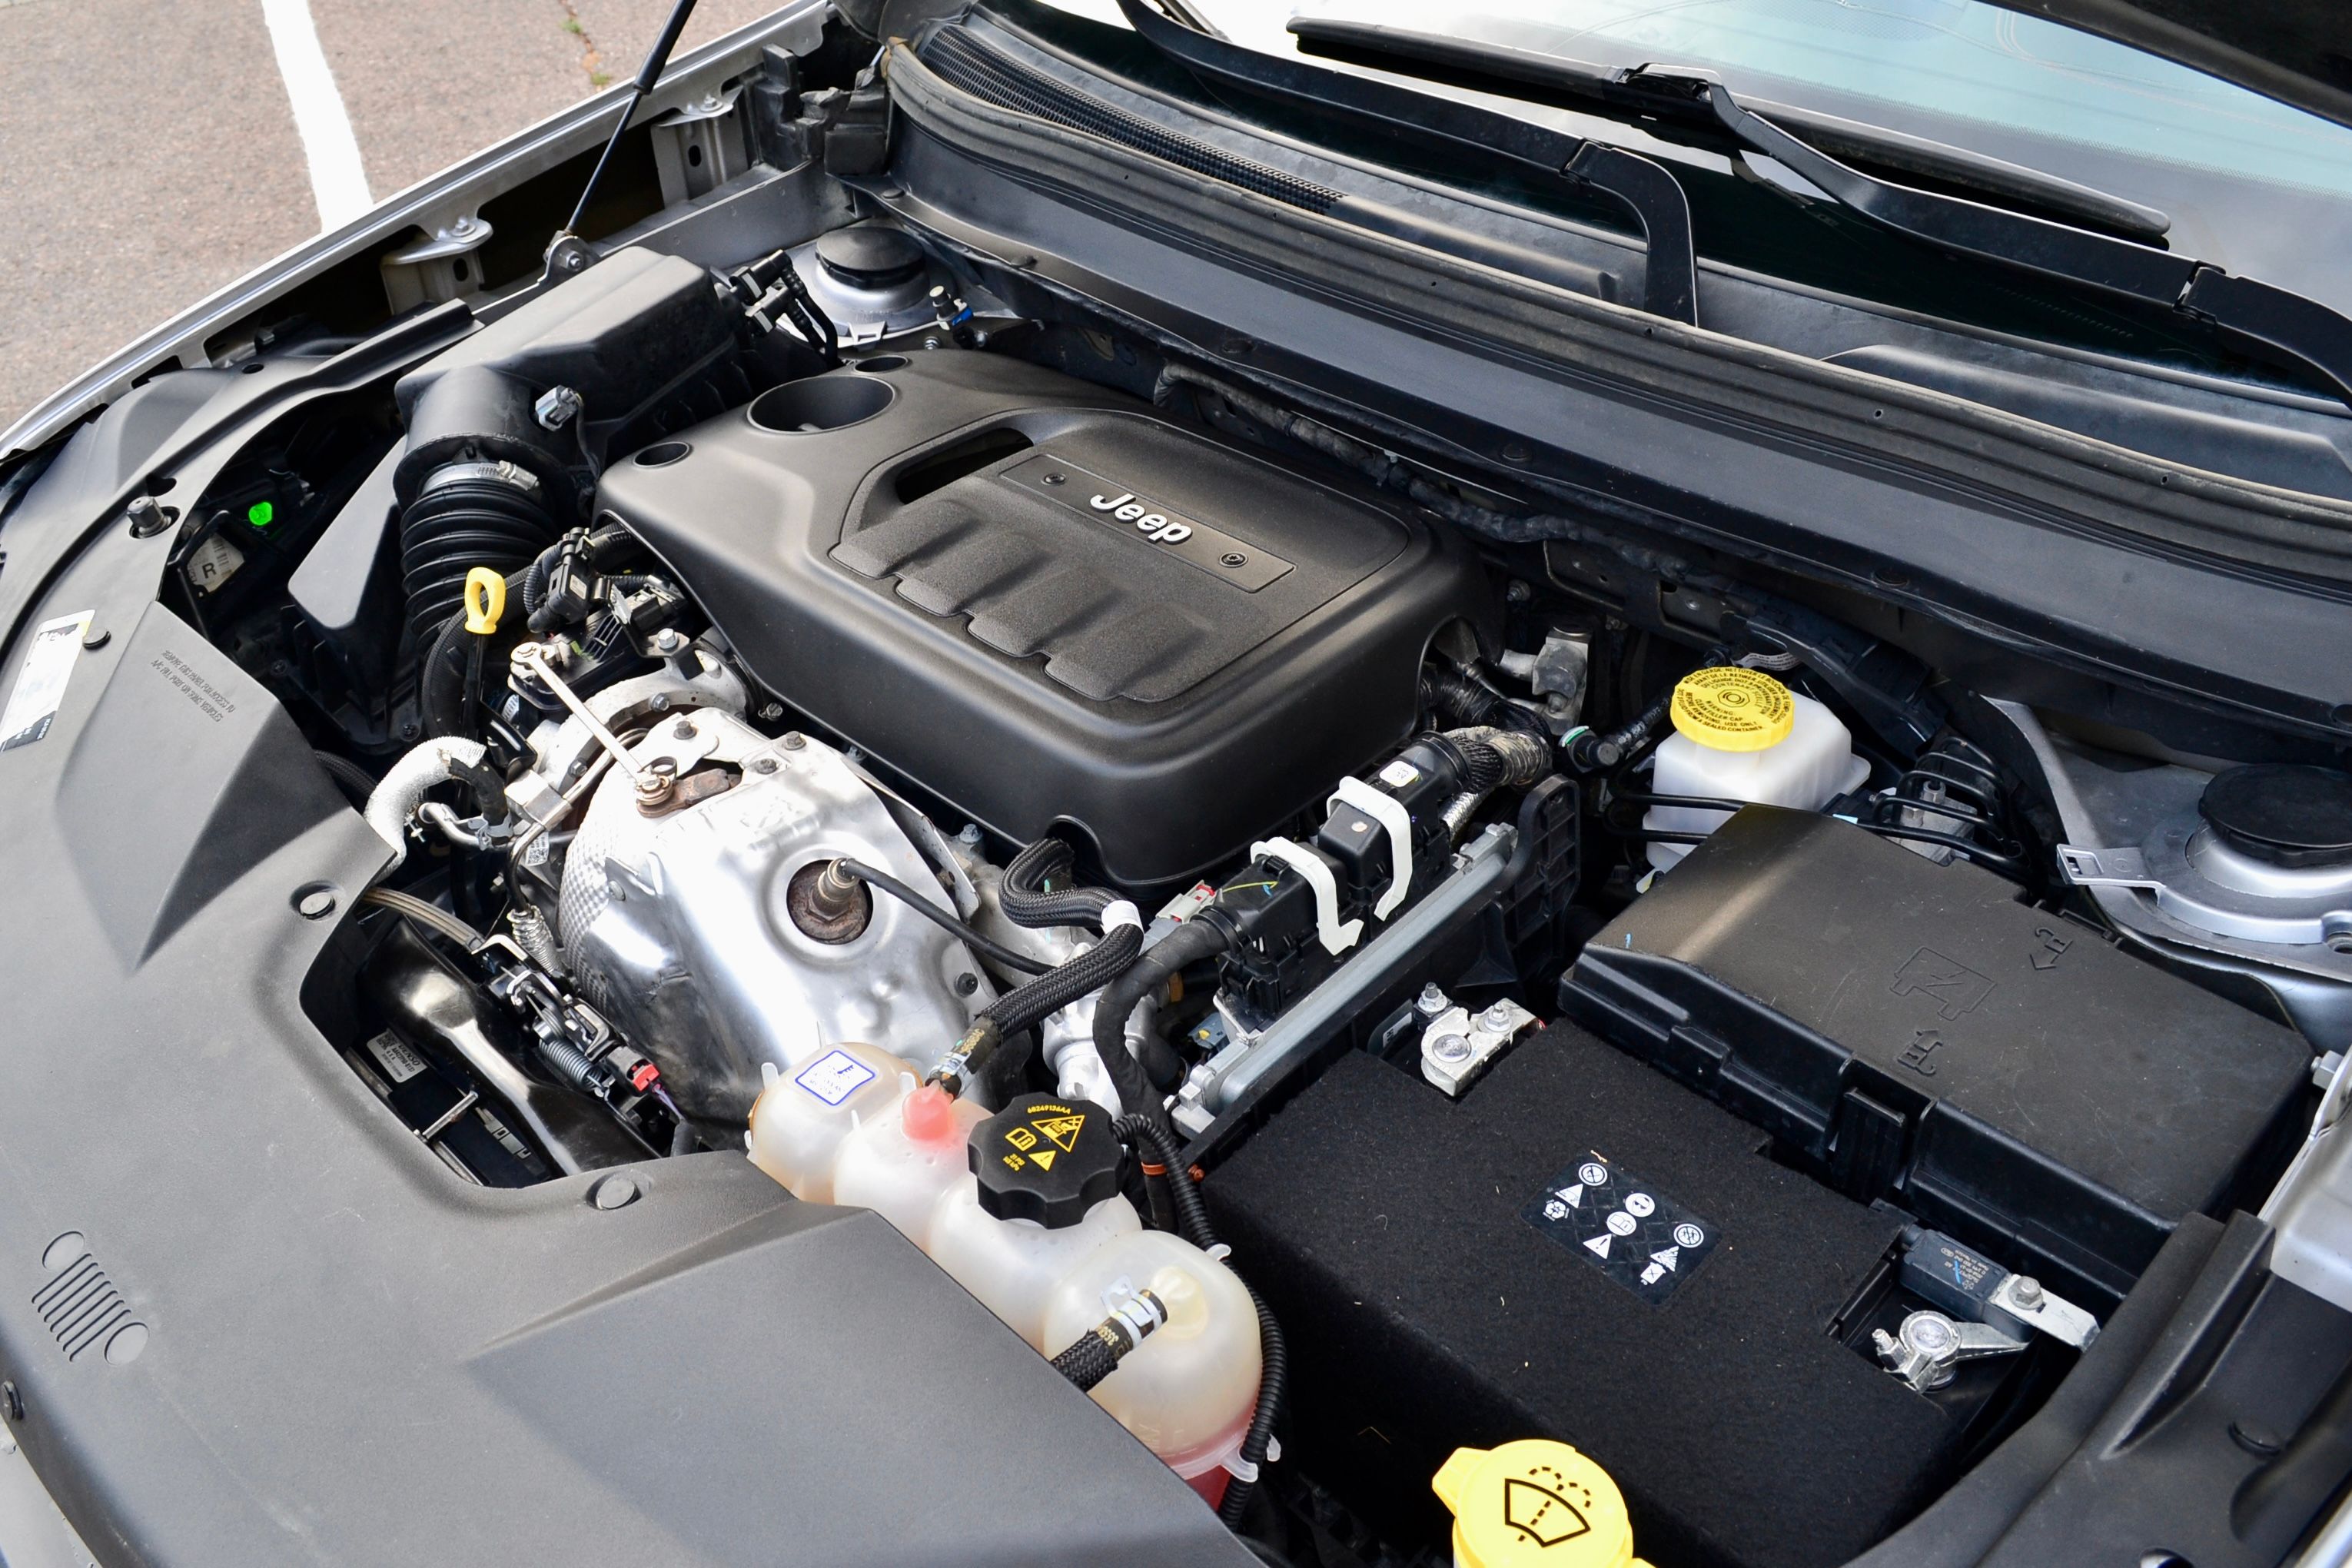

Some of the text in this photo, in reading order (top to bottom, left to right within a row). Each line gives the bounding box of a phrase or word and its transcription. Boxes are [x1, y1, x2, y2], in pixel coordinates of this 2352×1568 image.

[1090, 493, 1192, 543] Jeep
[201, 563, 217, 579] R
[398, 1045, 420, 1065] DENSO
